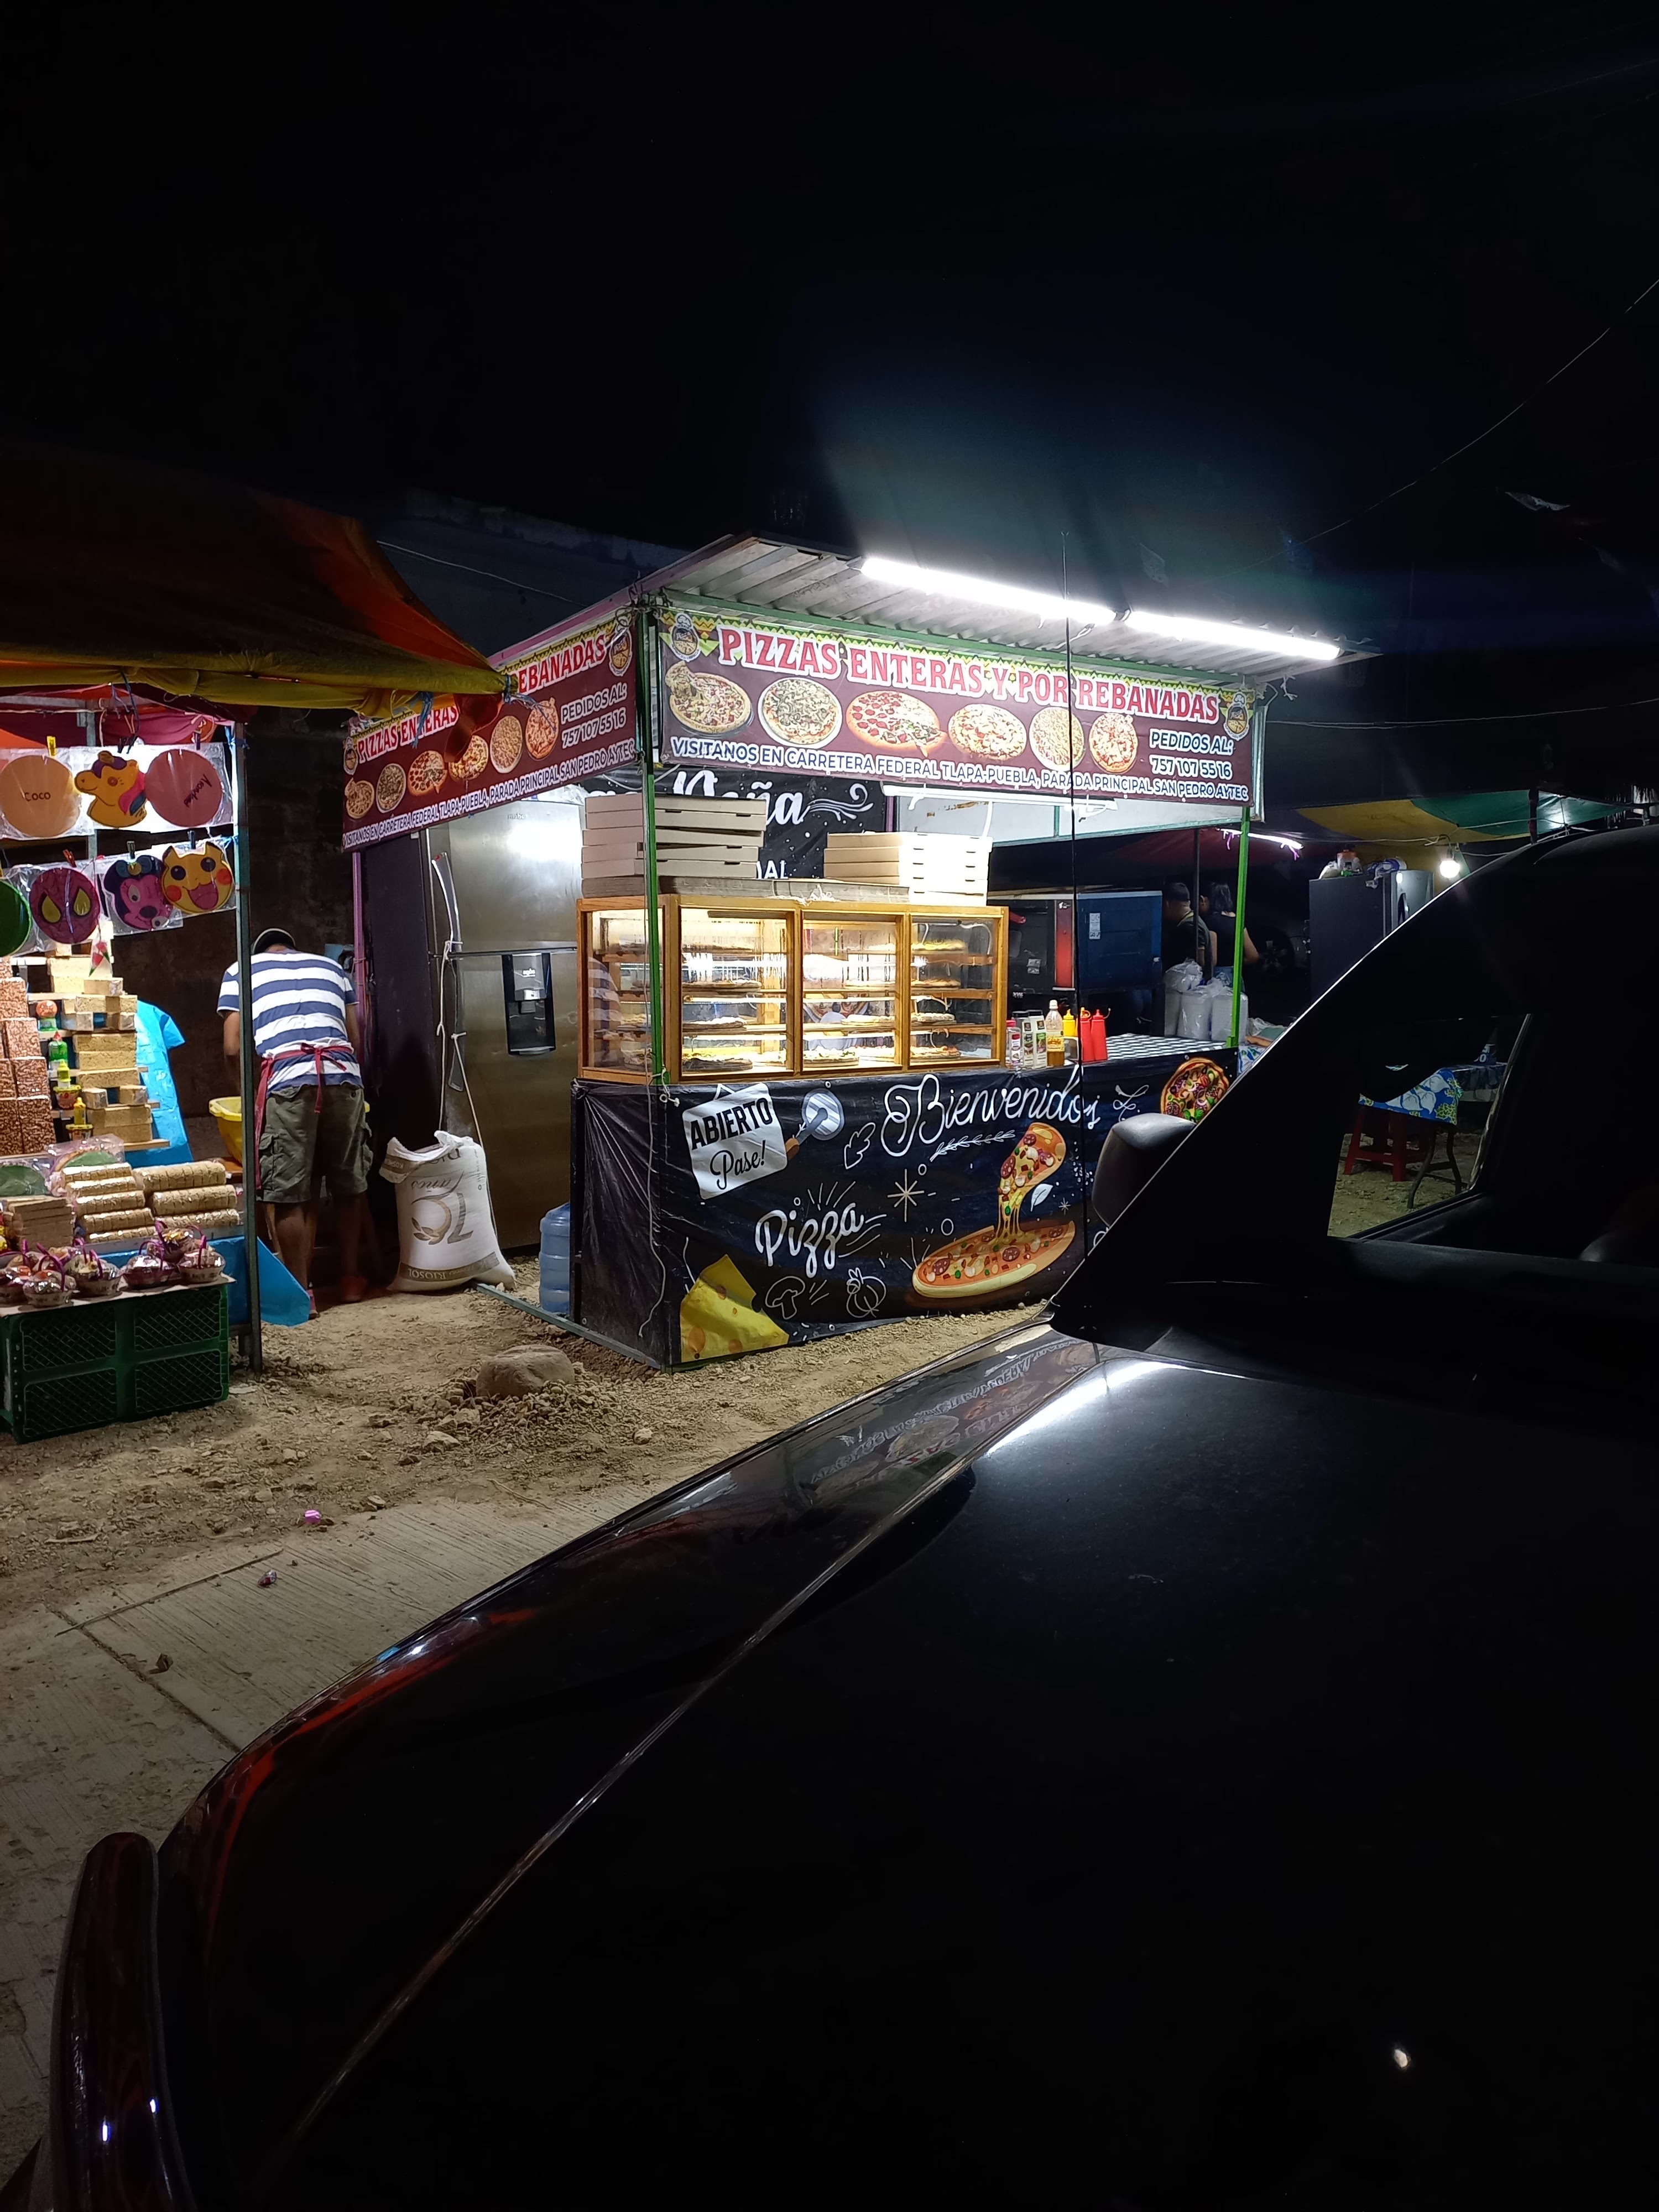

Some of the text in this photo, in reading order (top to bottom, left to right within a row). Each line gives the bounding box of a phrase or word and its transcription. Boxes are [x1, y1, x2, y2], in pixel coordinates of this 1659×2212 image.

[518, 634, 606, 693] EBANADAS
[721, 629, 836, 674] PIZZAS
[851, 648, 982, 692] ENTERAS
[993, 667, 1009, 696] Y
[1018, 670, 1068, 704] POR
[1078, 679, 1218, 722] REBANADAS
[562, 683, 627, 722] PEDIDOS AL:
[563, 709, 626, 747] 757 107 55 16
[358, 724, 398, 761] PIZZAS
[1151, 732, 1233, 754] PEDIDOS AL:
[1151, 757, 1232, 778] 757 107 55 16
[672, 738, 1249, 801] VISITANOS EN CARRETERA FEDERAL TLAPA-PUEBLA, PARADA PRINCIPAL SAN PEDRO AYTEC
[342, 826, 369, 847] VISITANOS
[379, 816, 411, 837] CARRETERA
[412, 810, 439, 828] FEDERAL
[491, 779, 519, 801] PARADA
[520, 766, 559, 791] PRINCIPAL
[560, 761, 578, 779] SAN
[580, 750, 607, 773] PEDRO
[691, 1097, 773, 1151] ABIERTO
[880, 1064, 1102, 1157] Bienvenidos
[709, 1140, 766, 1190] Pase!
[755, 1202, 865, 1279] Pizza
[408, 1269, 447, 1280] RIOSOL
